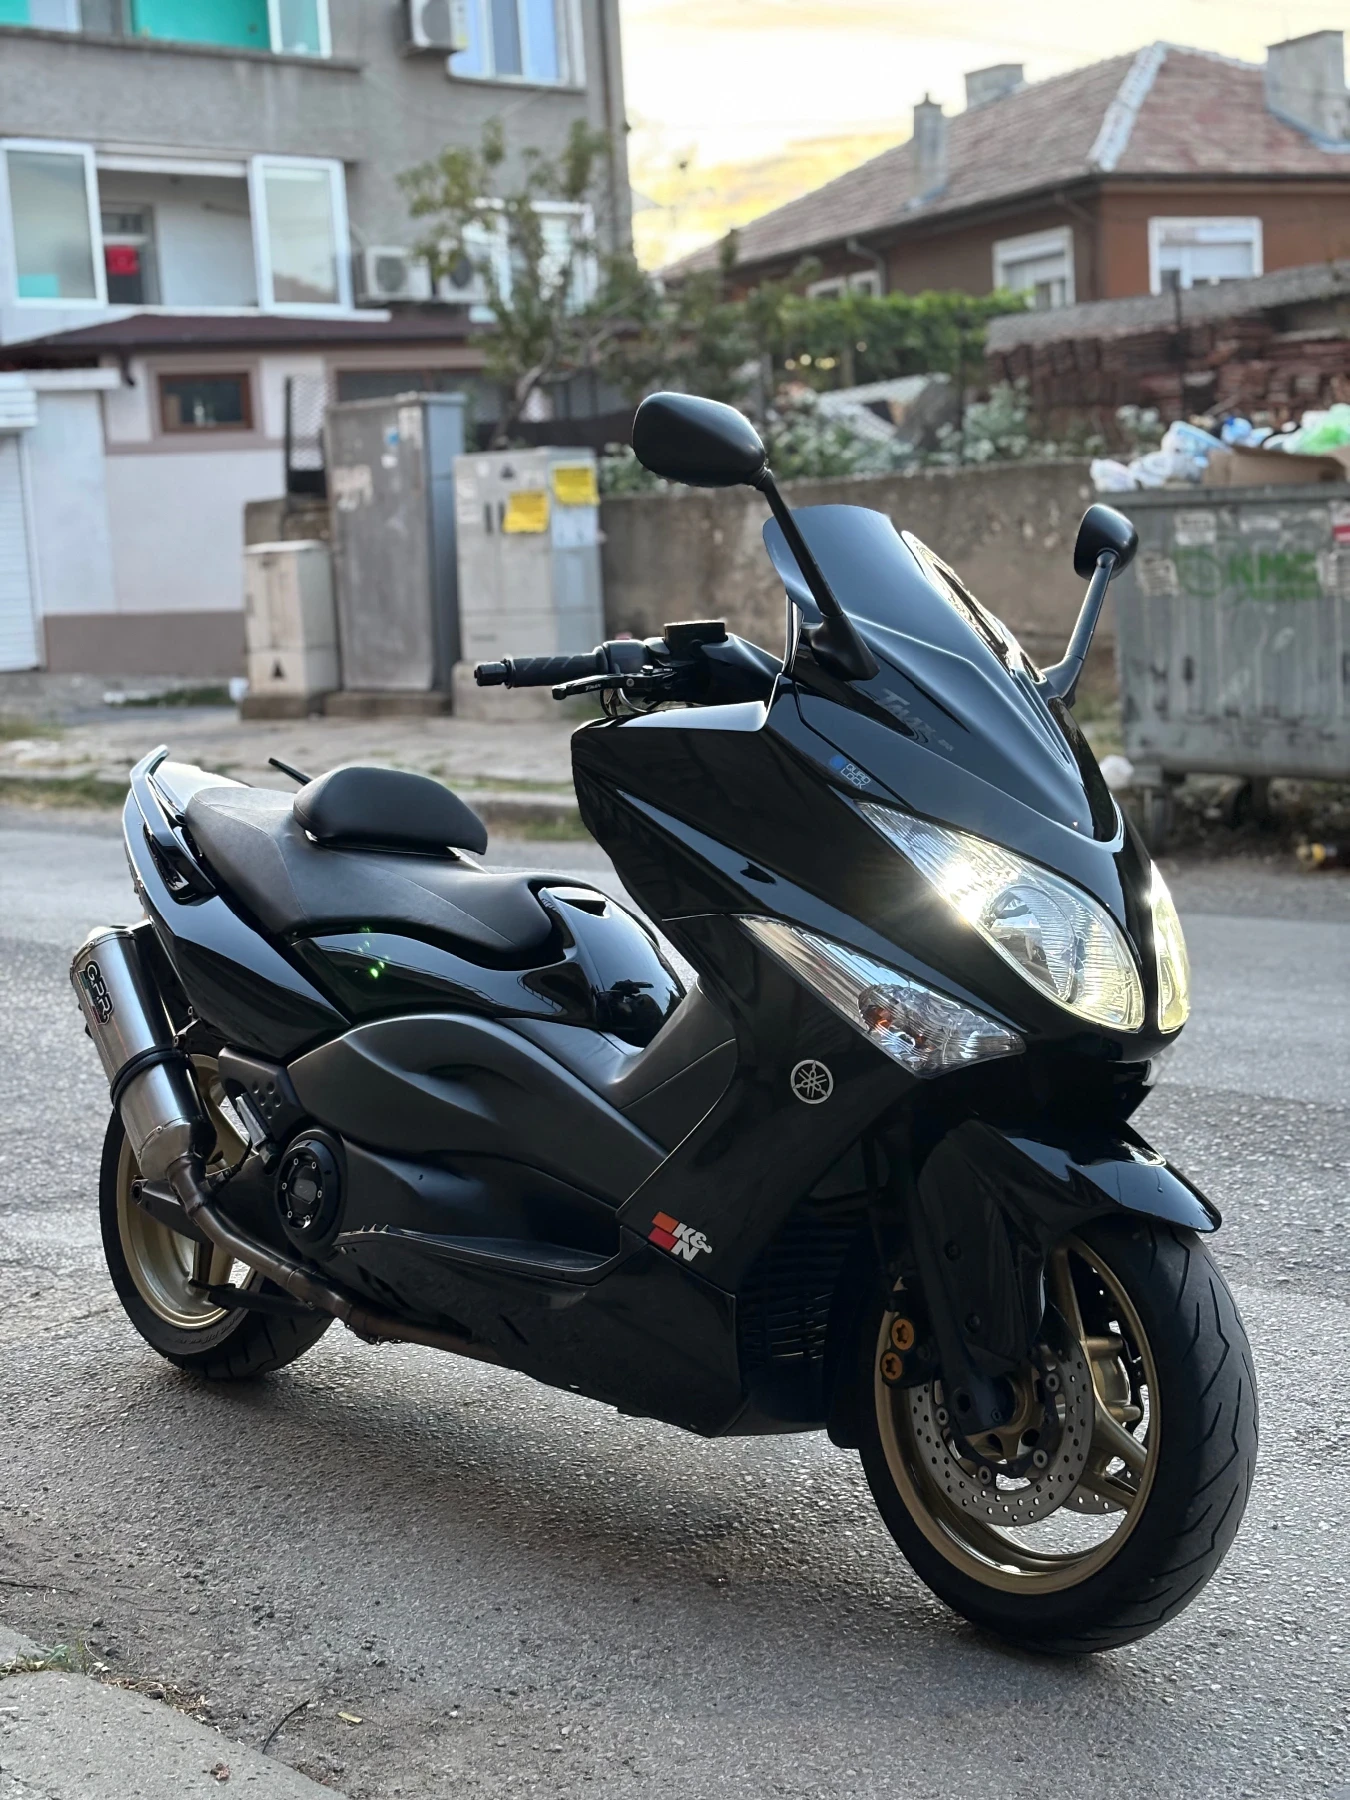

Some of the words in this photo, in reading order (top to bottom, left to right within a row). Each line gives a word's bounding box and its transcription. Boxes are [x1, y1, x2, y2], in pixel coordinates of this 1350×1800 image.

[840, 767, 866, 790] LOCK
[846, 763, 871, 784] QUAD
[86, 963, 112, 1020] GPR
